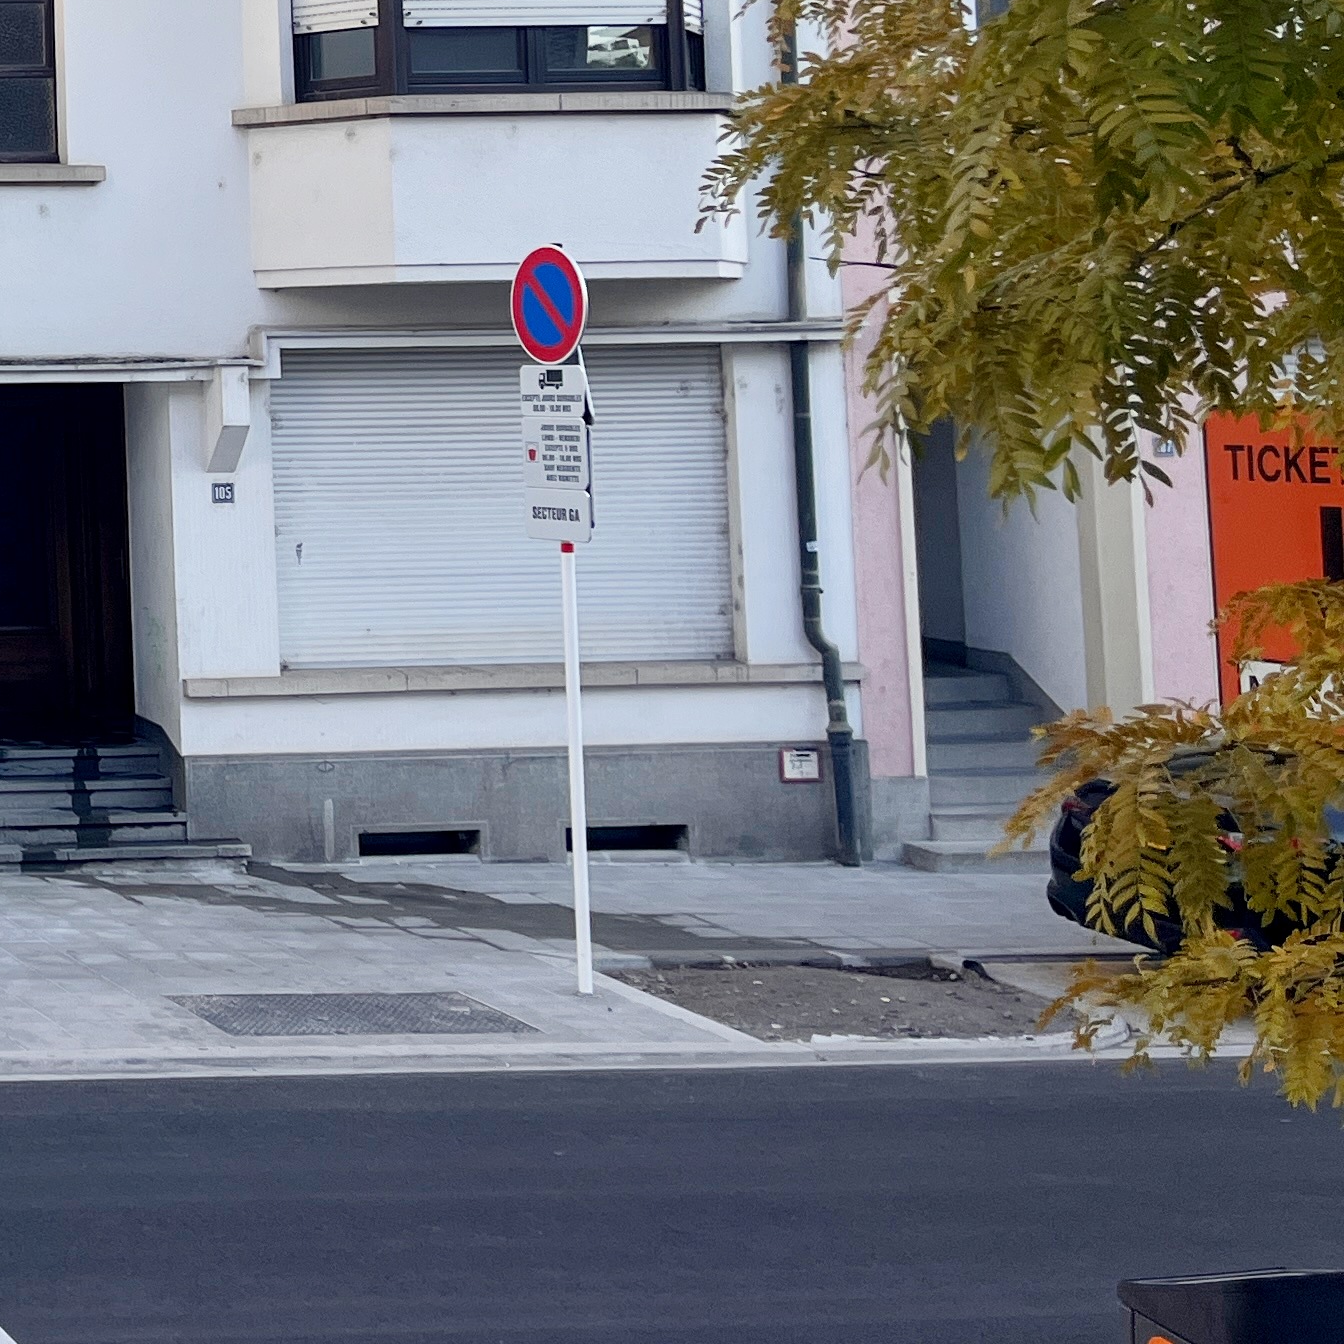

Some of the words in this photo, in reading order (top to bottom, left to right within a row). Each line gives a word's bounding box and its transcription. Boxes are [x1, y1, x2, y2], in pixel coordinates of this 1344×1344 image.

[1223, 442, 1344, 485] TICKE
[214, 486, 232, 500] 105
[532, 506, 567, 521] SECTEUR
